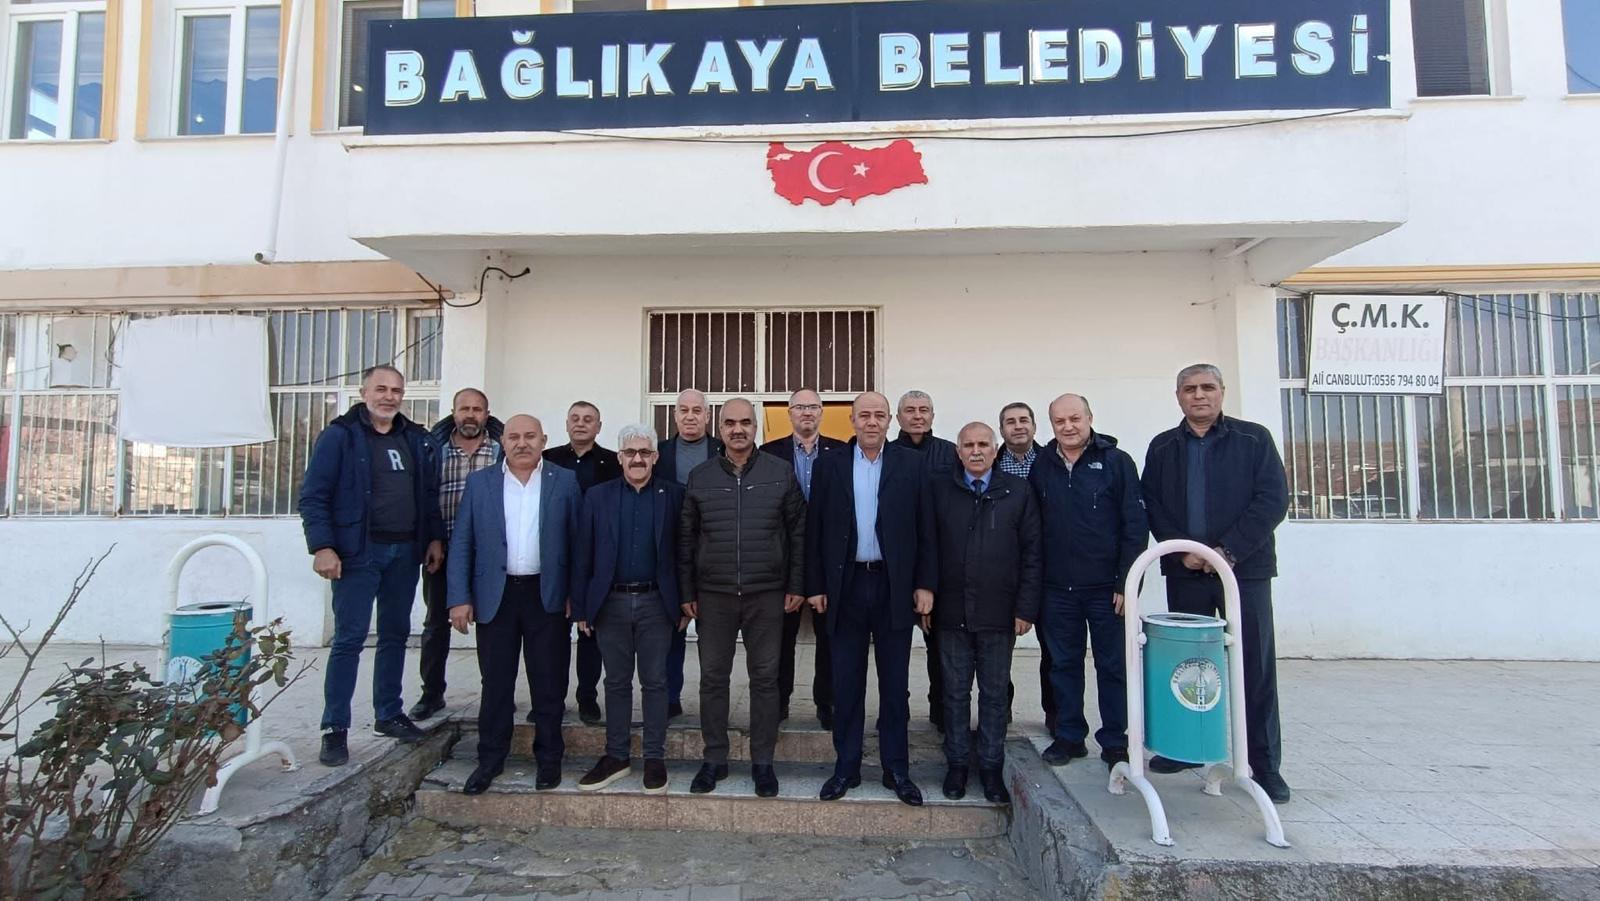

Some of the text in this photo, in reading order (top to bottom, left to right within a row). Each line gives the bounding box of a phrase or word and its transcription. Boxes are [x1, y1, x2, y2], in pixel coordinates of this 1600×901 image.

[384, 30, 835, 106] BAĞLIKAYA
[1331, 302, 1430, 334] Ç.M.K.
[1397, 374, 1414, 387] 794
[1415, 374, 1427, 388] 80
[1428, 374, 1440, 388] 04
[387, 449, 405, 471] R
